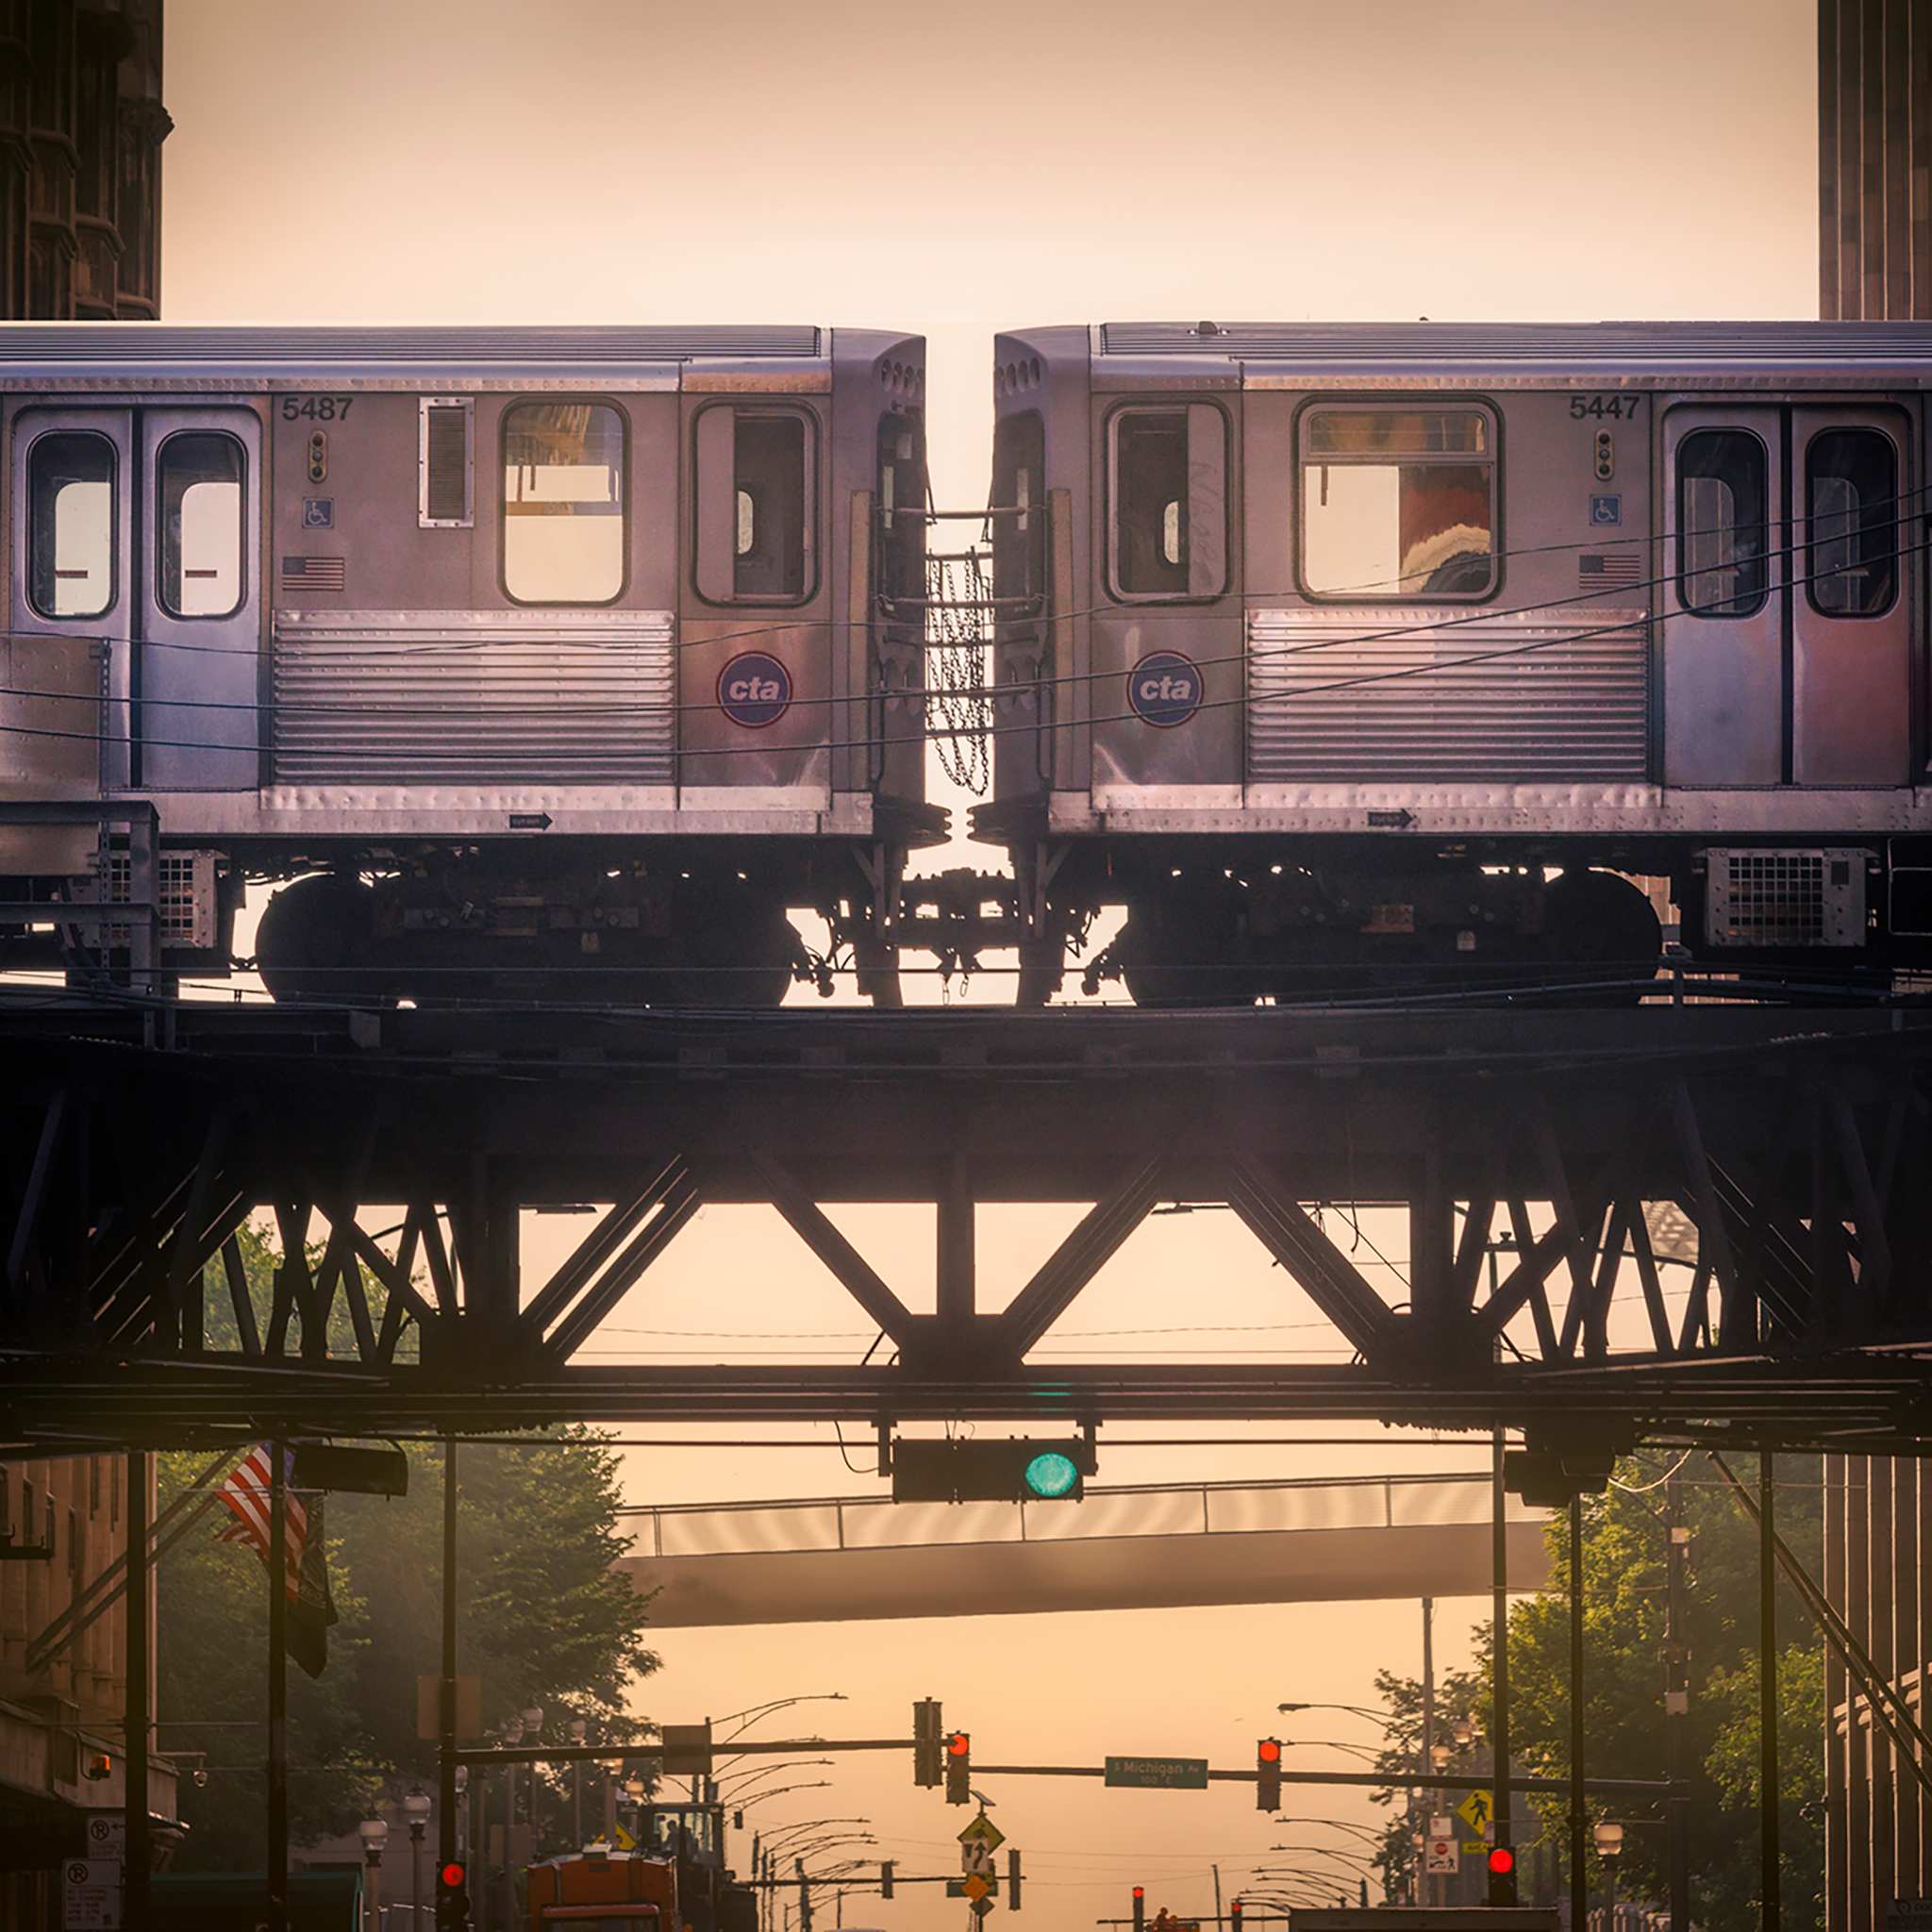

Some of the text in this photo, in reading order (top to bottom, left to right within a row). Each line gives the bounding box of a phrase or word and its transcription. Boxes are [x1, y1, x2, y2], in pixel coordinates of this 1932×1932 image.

[282, 397, 353, 421] 5487
[1568, 395, 1640, 420] 5447
[729, 676, 779, 701] cta
[1140, 675, 1191, 700] cta
[1114, 1761, 1121, 1772] S
[1124, 1760, 1183, 1777] Michigan
[1141, 1775, 1158, 1785] 100
